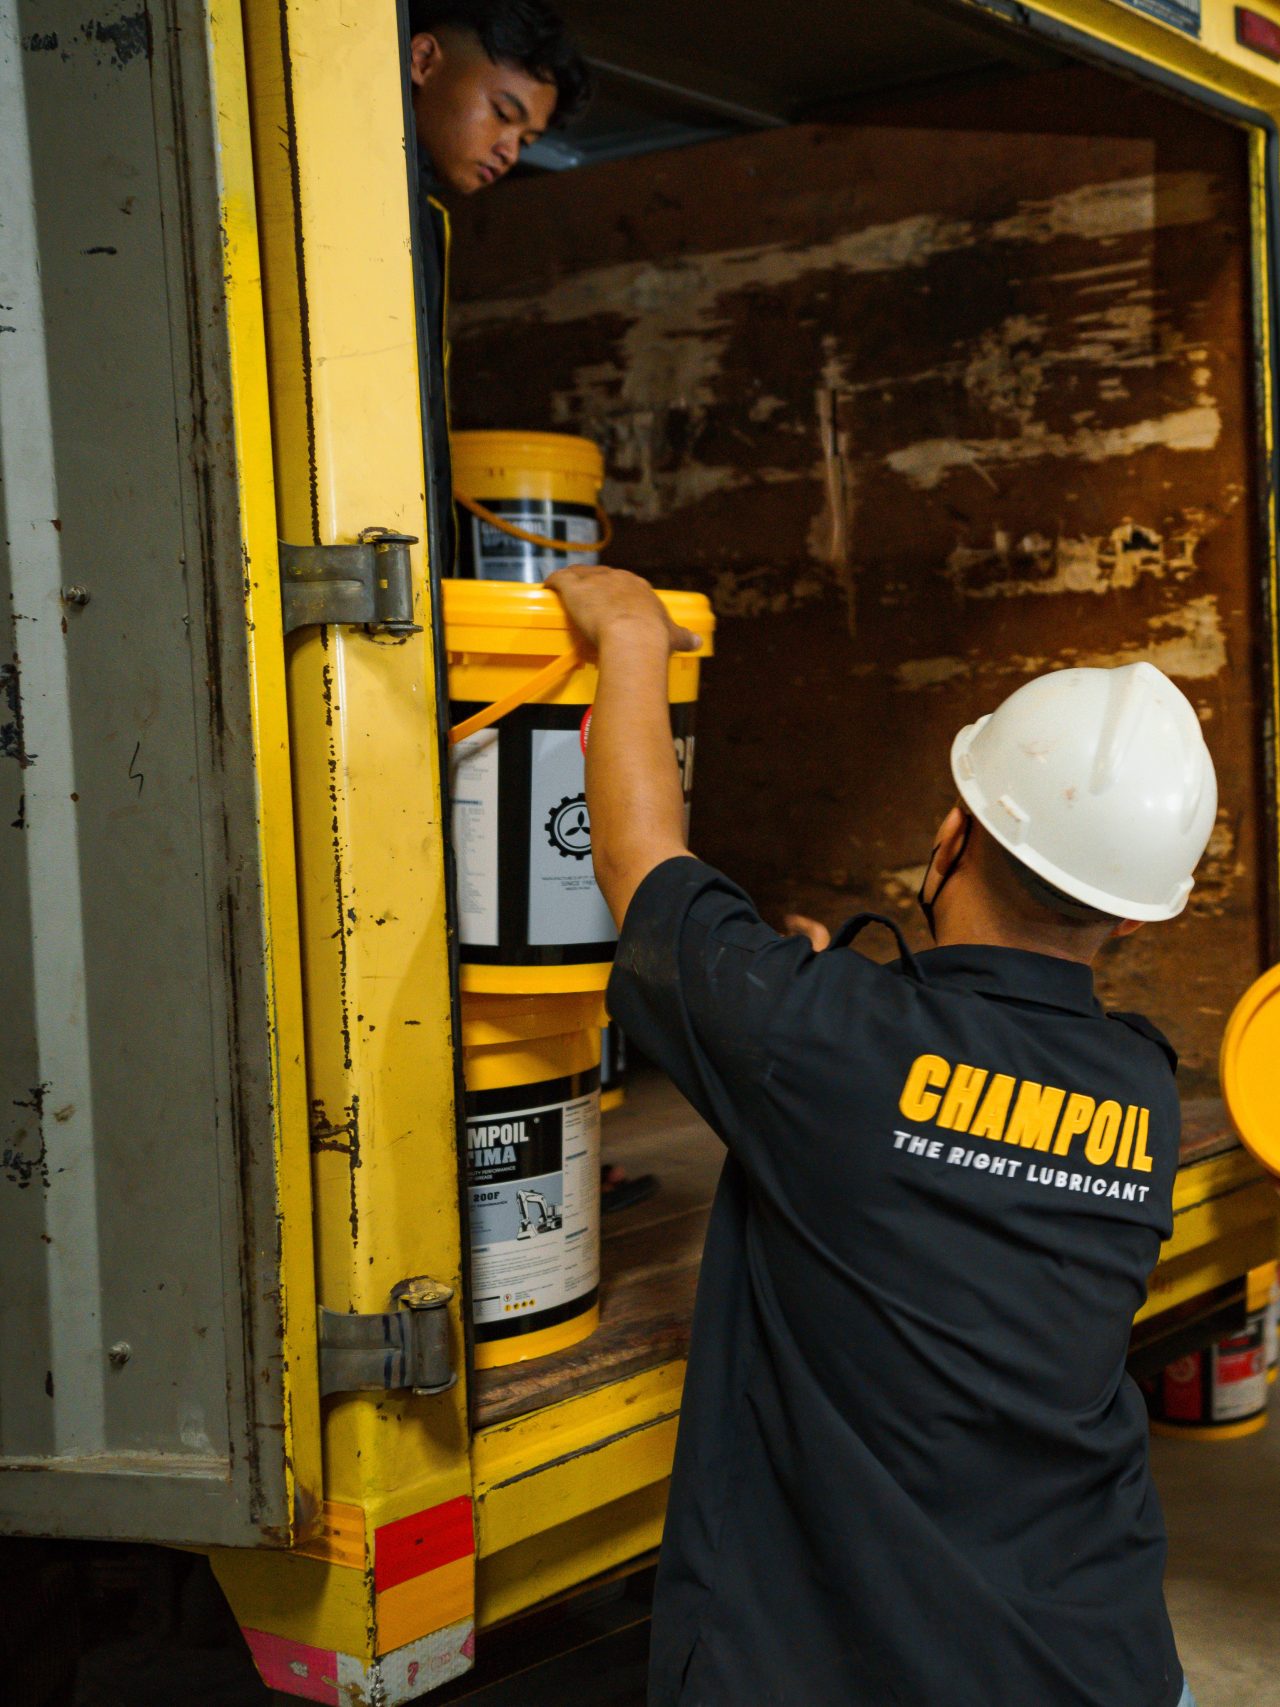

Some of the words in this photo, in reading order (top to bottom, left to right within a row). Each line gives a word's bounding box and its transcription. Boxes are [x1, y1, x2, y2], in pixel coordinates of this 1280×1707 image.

[899, 1054, 1154, 1173] CHAMPOIL
[893, 1130, 945, 1160] THE
[947, 1147, 1022, 1178] RIGHT
[1026, 1163, 1150, 1203] LUBRICANT
